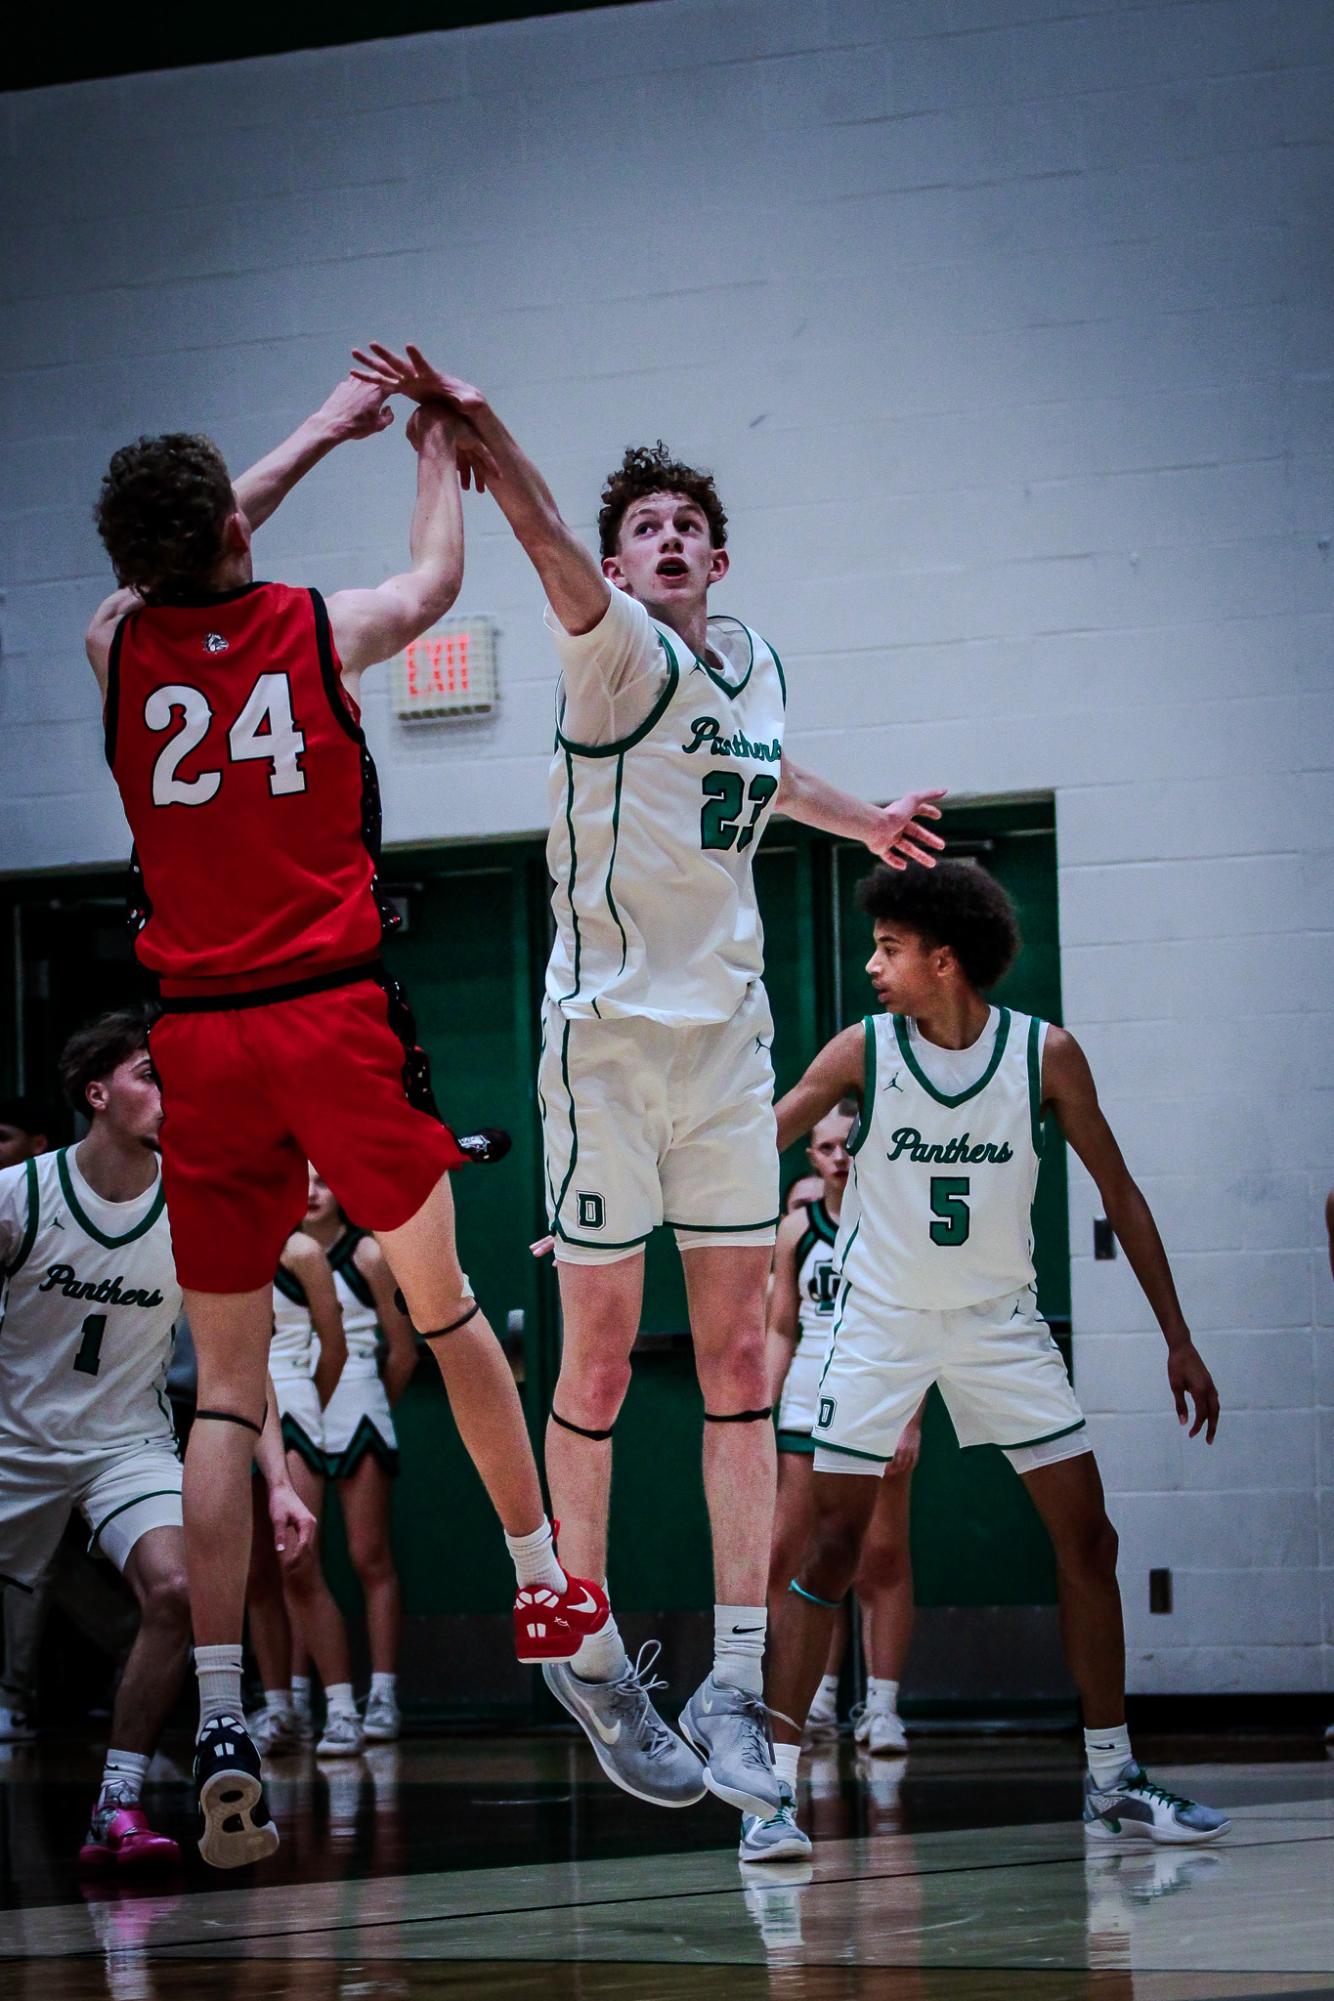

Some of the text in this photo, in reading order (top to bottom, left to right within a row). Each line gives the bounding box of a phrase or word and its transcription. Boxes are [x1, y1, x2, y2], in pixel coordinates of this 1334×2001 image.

[404, 633, 471, 698] EXIT
[142, 671, 307, 808] 24
[886, 1127, 1014, 1164] Panthers
[576, 1190, 606, 1231] D
[929, 1176, 971, 1247] 5
[39, 1264, 164, 1308] Panthers
[73, 1314, 107, 1376] 1
[815, 1395, 838, 1431] D
